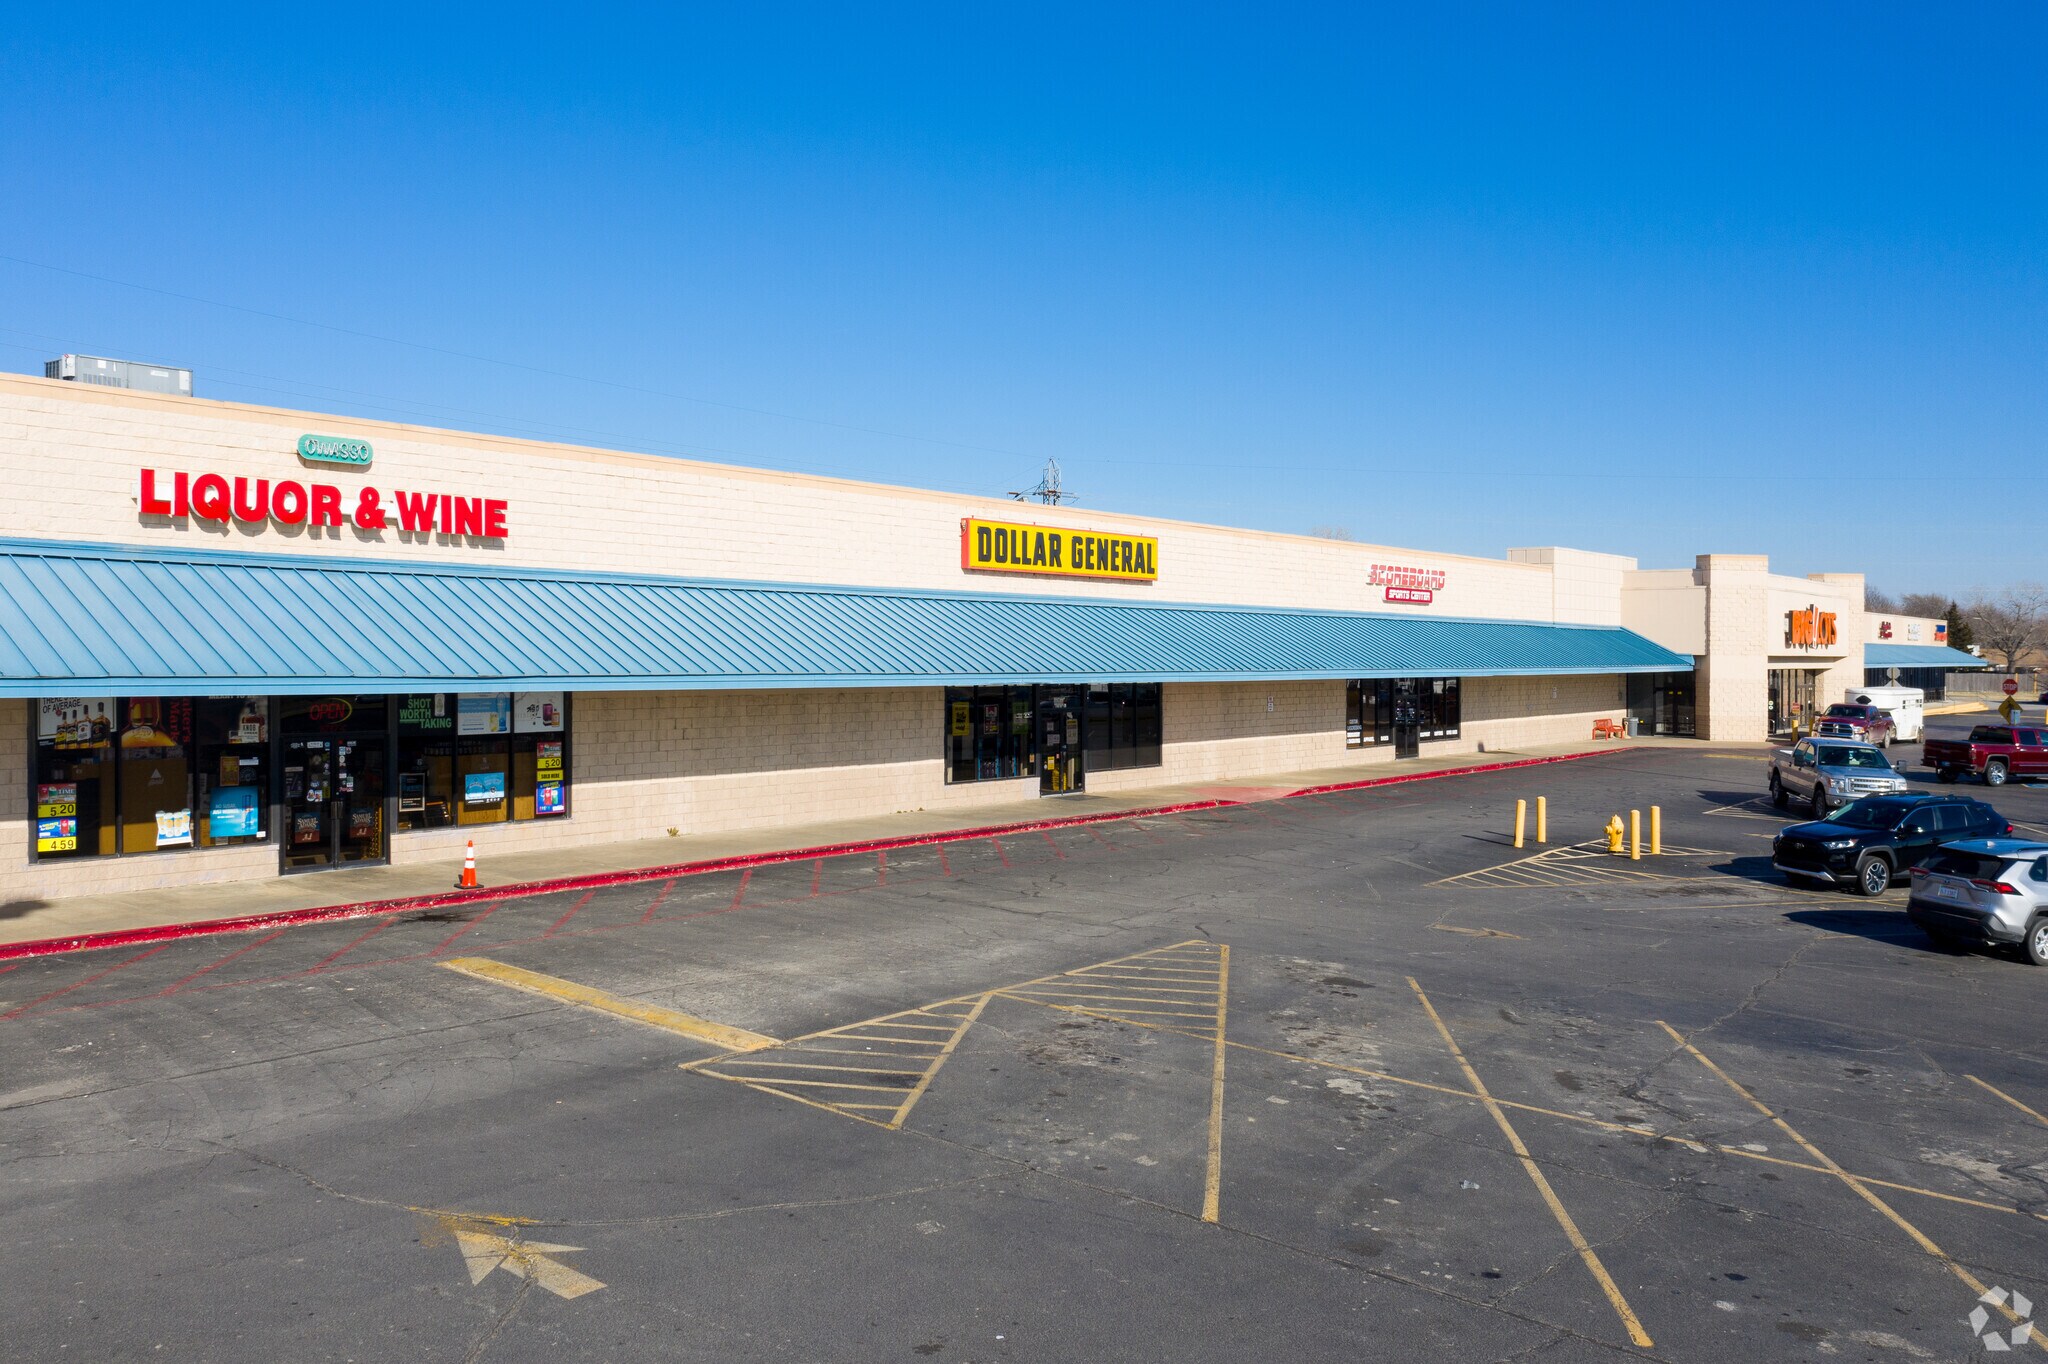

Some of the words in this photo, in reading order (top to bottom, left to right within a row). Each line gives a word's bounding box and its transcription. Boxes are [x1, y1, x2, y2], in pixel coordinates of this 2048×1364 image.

[305, 438, 369, 461] OWASSO
[140, 468, 343, 527] LIQUOR
[352, 486, 388, 530] &
[394, 490, 508, 538] WINE
[977, 526, 1062, 568] DOLLAR
[1071, 535, 1155, 574] GENERAL
[1369, 564, 1446, 589] SCOREBOARD
[1388, 589, 1410, 599] SPORTS
[2003, 683, 2017, 691] STOP
[42, 704, 51, 714] OF
[408, 699, 431, 709] SHOT
[310, 703, 345, 720] OPEN
[400, 709, 431, 719] WORTH
[420, 718, 452, 728] TAKING
[50, 804, 75, 817] 5.20
